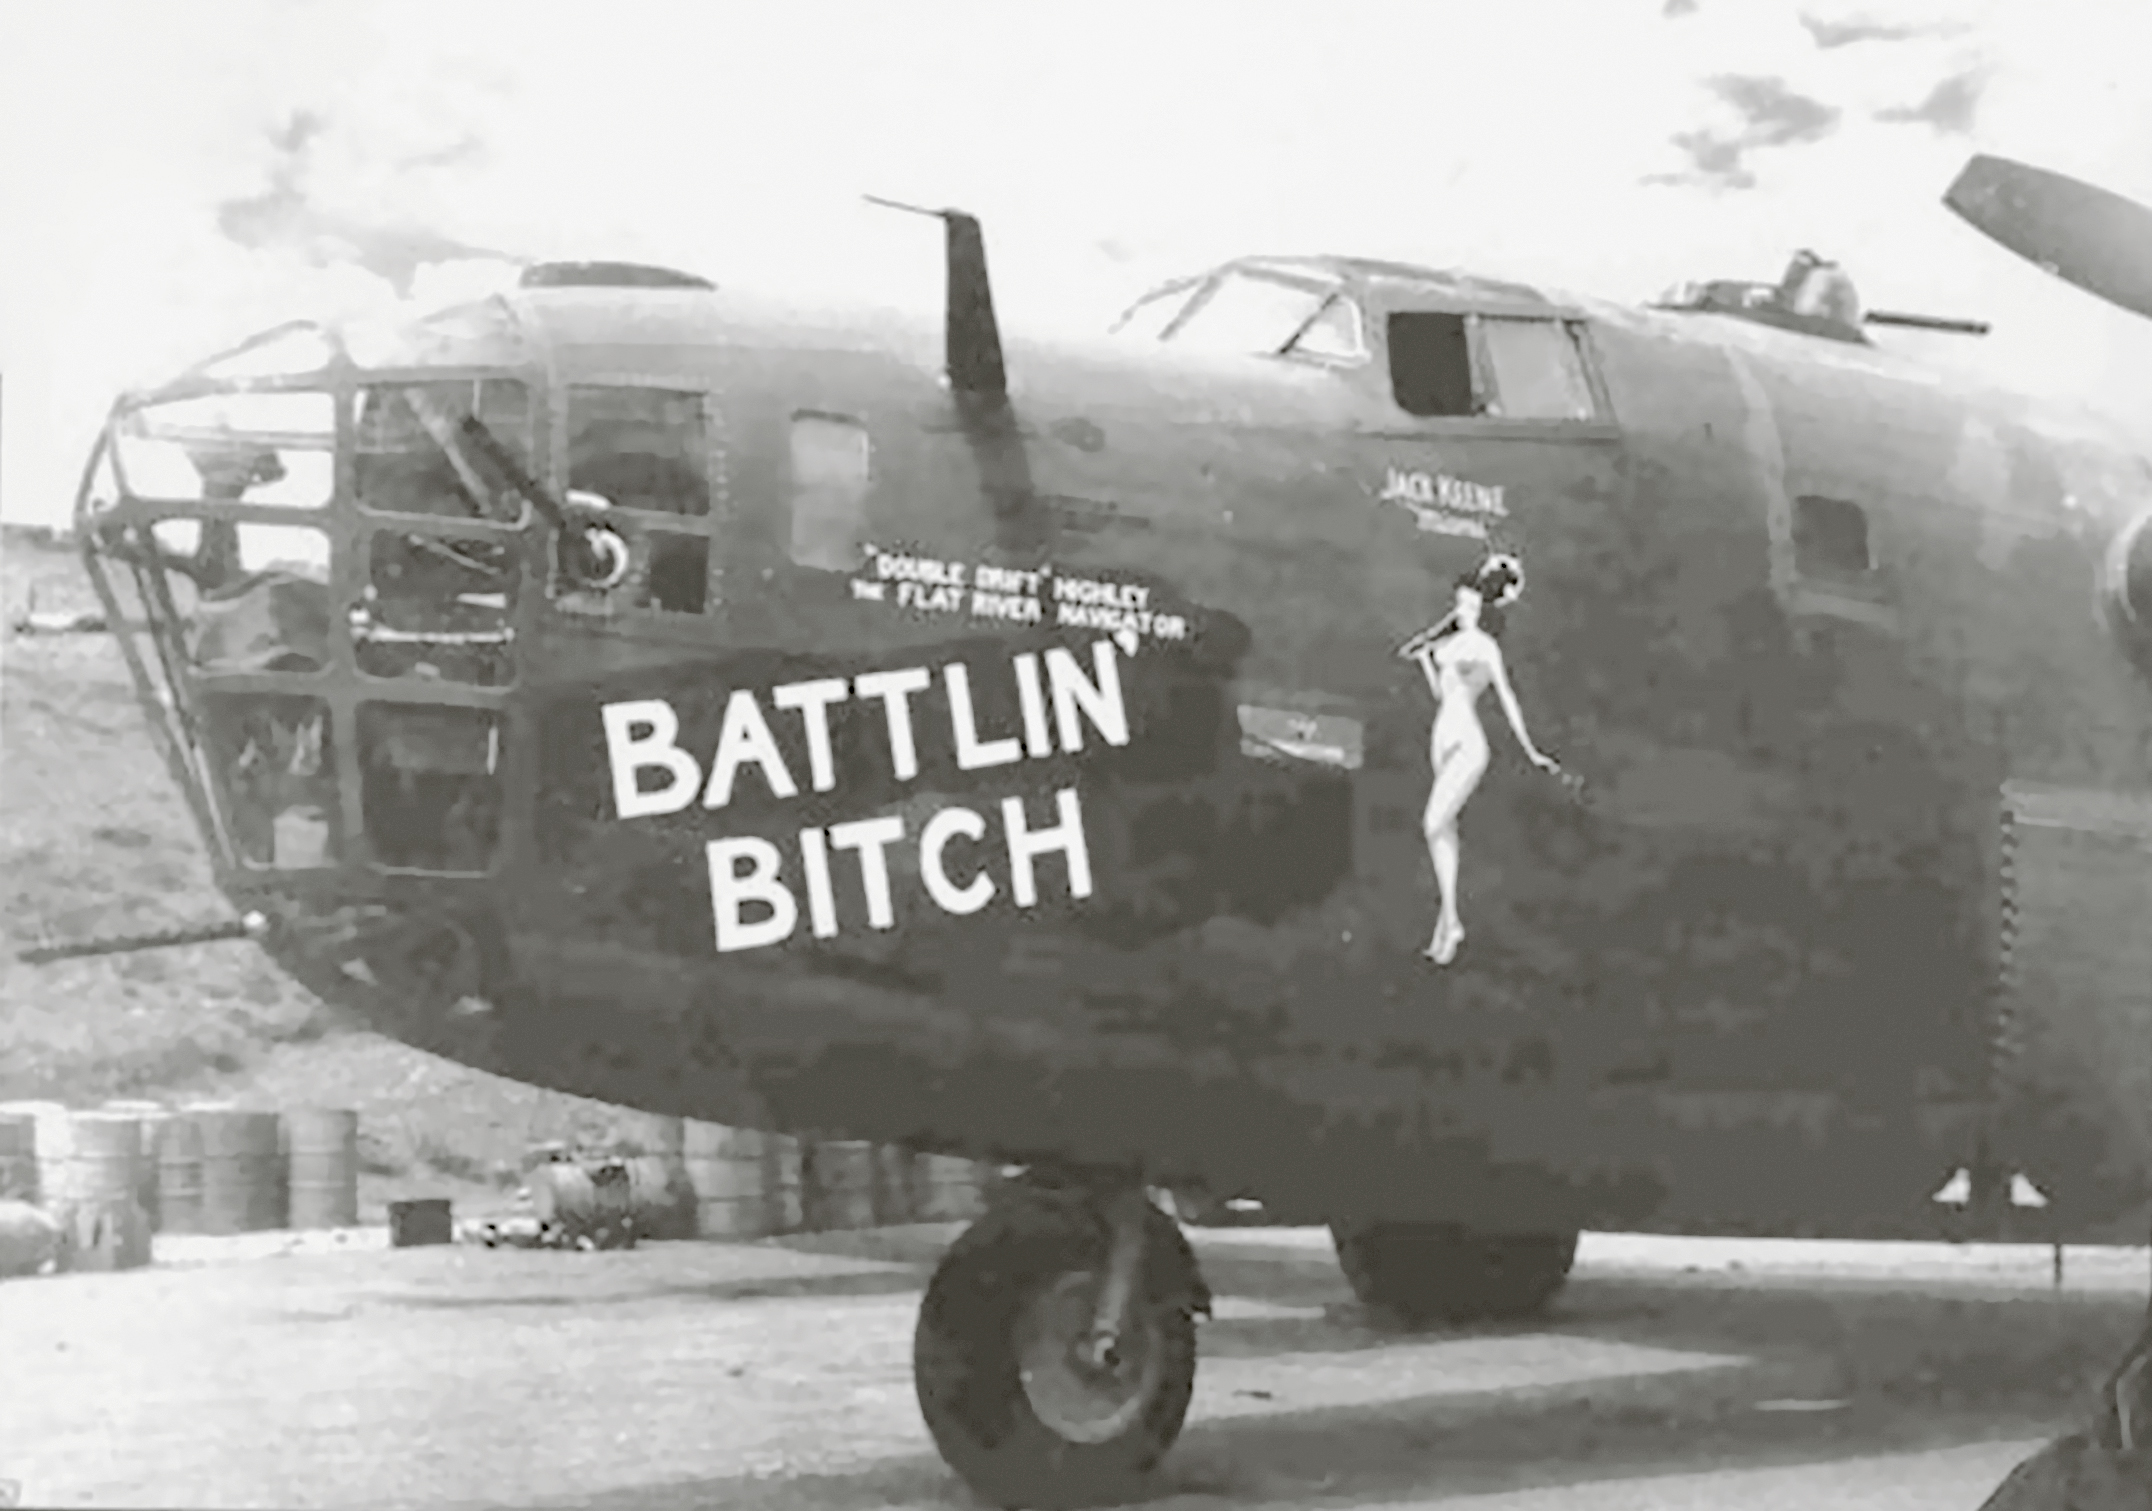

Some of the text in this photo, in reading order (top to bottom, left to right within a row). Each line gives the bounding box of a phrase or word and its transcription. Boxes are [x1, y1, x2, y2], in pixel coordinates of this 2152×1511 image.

[897, 580, 964, 613] FLAT
[1056, 600, 1187, 641] NAVIGATOR
[706, 788, 1092, 951] BITCH
